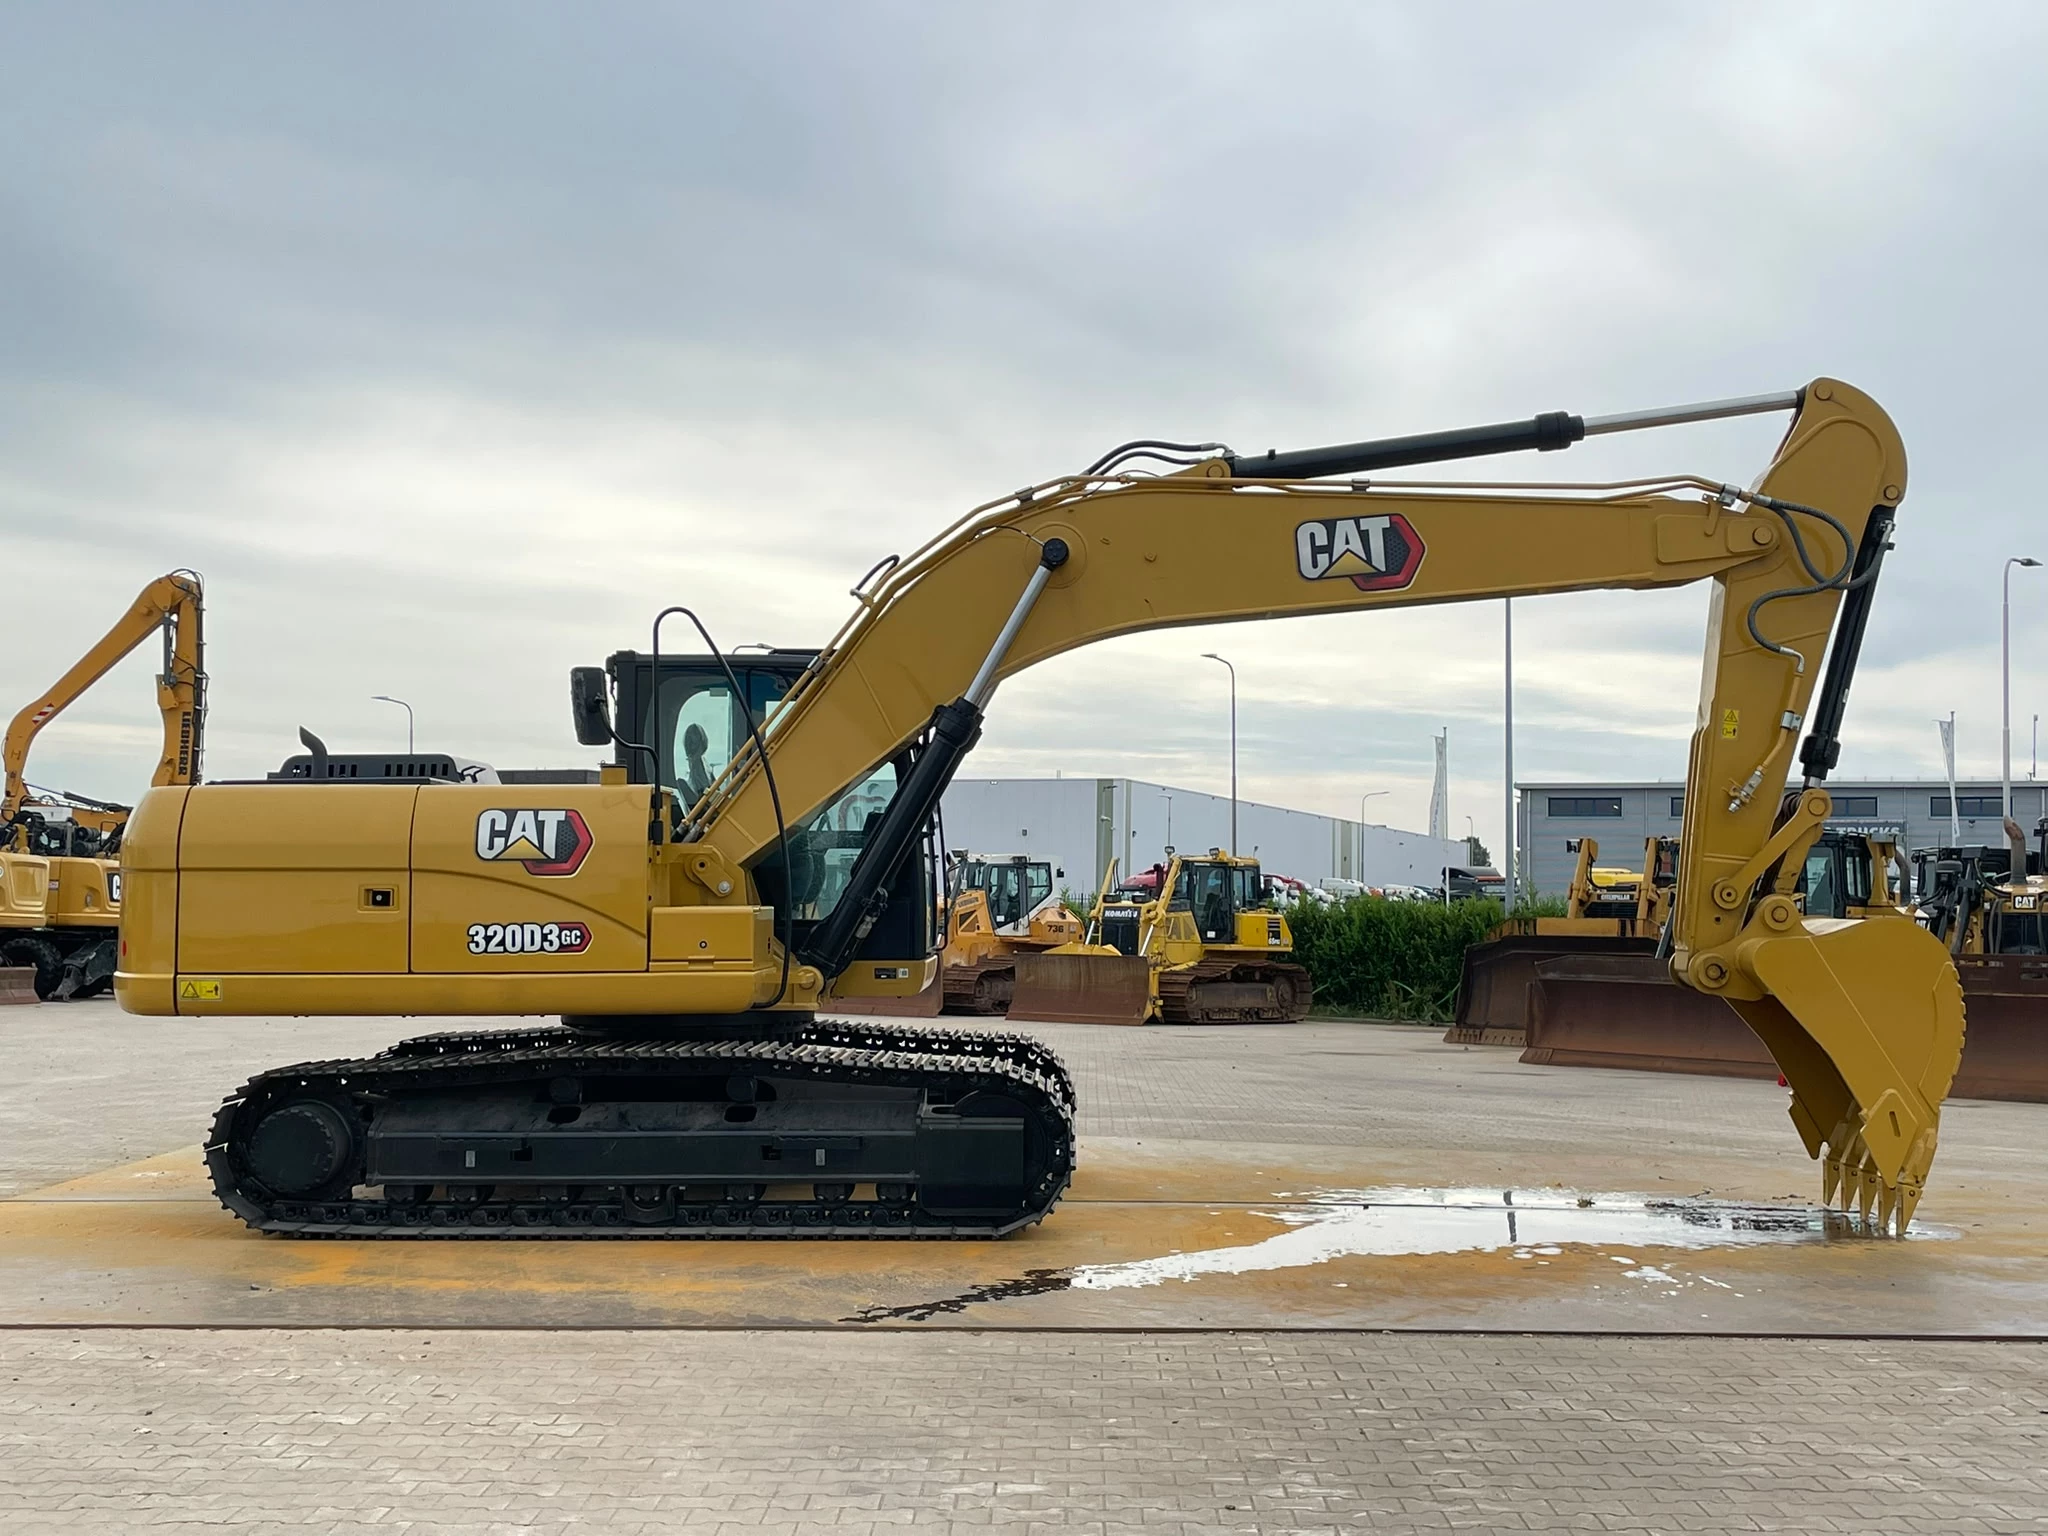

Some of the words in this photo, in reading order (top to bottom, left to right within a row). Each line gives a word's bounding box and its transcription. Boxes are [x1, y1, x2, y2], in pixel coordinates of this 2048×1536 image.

[1297, 516, 1391, 579] CAT
[178, 711, 191, 776] LIEBHERR
[477, 810, 567, 860] CAT
[1104, 909, 1138, 918] KOMATSU
[2015, 896, 2035, 909] CAT
[468, 923, 560, 953] 320D3
[561, 930, 581, 945] GC
[1047, 924, 1064, 933] 736
